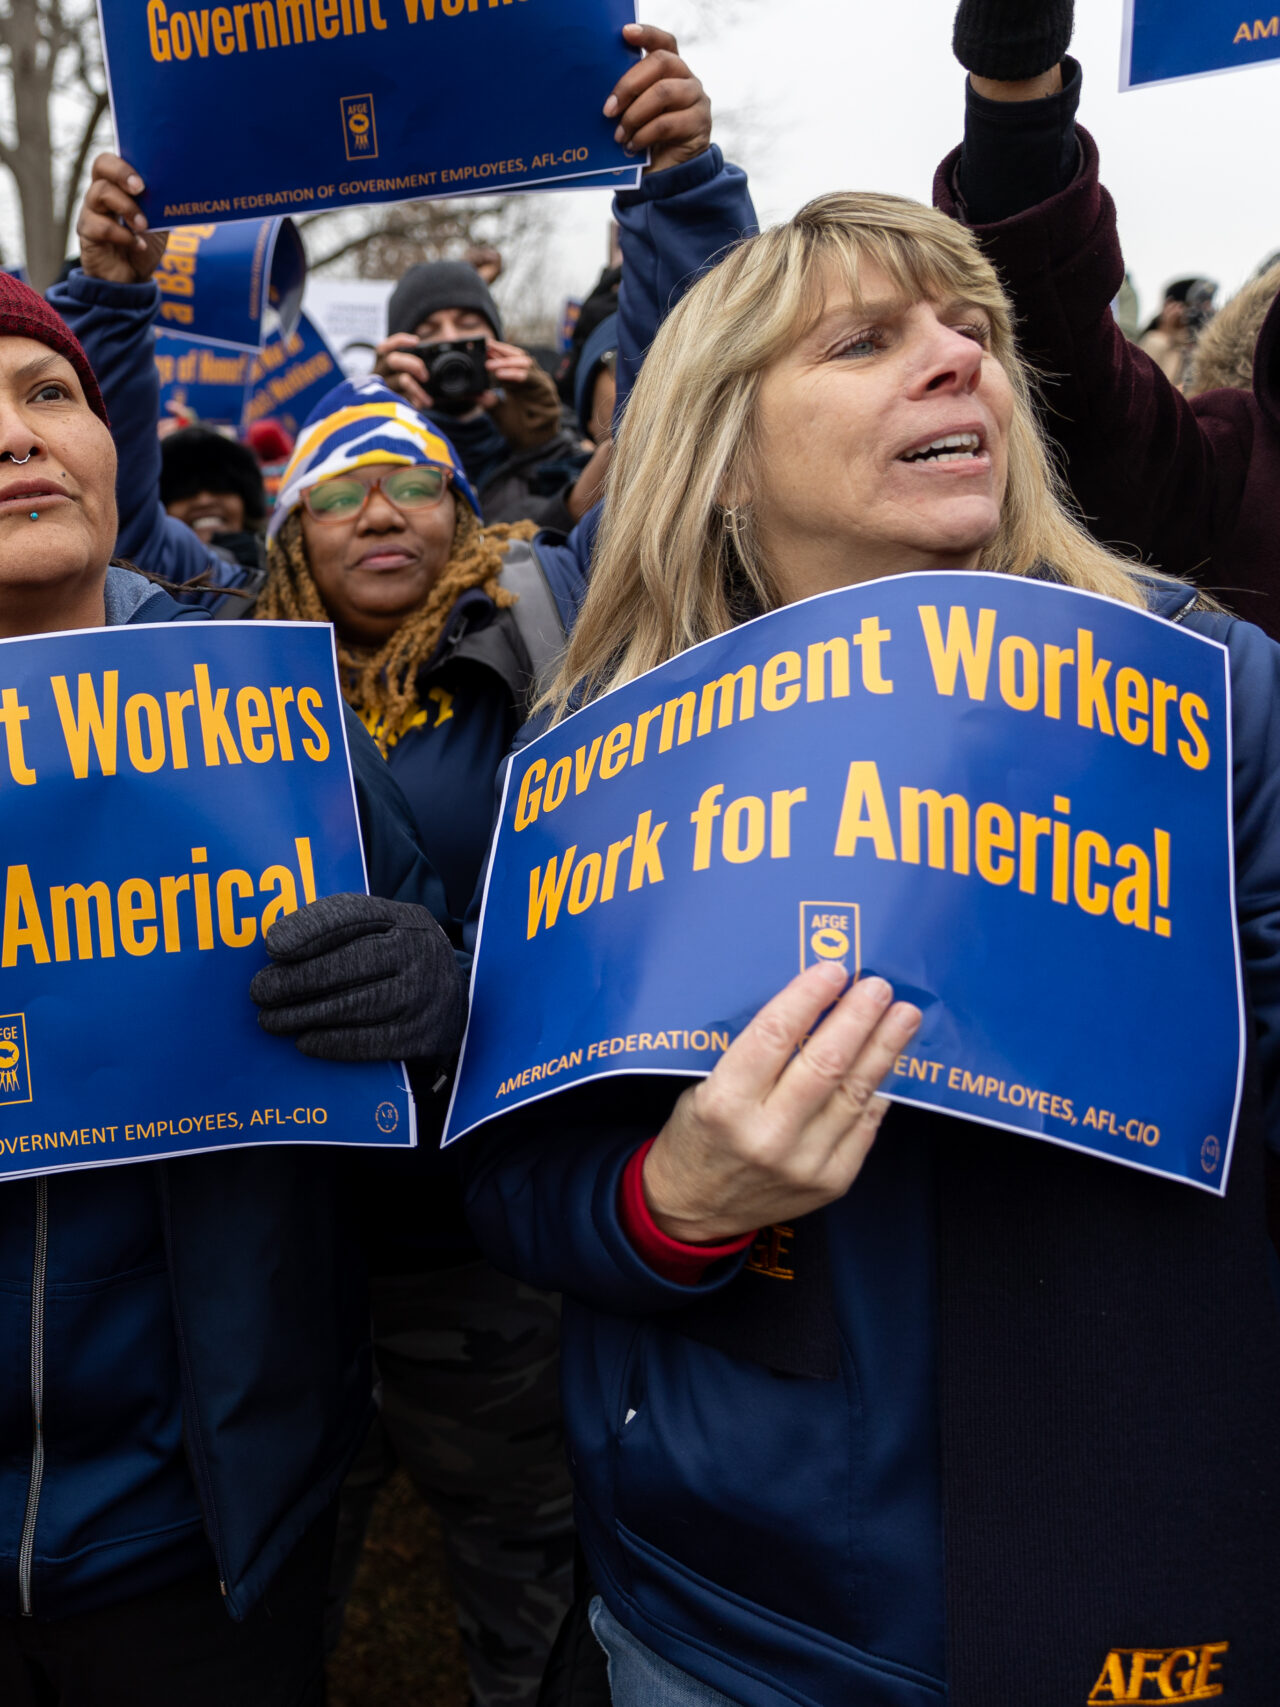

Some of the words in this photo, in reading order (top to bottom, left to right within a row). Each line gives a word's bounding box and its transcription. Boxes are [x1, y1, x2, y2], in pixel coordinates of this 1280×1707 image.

[147, 0, 387, 62] Government
[347, 104, 368, 117] AFGE
[163, 199, 230, 216] AMERICAN
[234, 188, 315, 210] FEDERATION
[317, 184, 335, 199] OF
[339, 173, 435, 196] GOVERNMENT
[441, 159, 528, 182] EMPLOYEES,
[532, 147, 589, 168] AFL-CIO
[50, 663, 330, 779] Workers
[514, 616, 894, 832] Government
[919, 605, 1210, 770] Workers
[527, 809, 668, 940] Work
[690, 783, 807, 871] for
[834, 761, 1171, 937] America!
[811, 915, 849, 931] AFGE
[497, 1048, 583, 1099] AMERICAN
[587, 1030, 729, 1060] FEDERATION
[124, 1112, 245, 1141] EMPLOYEES,
[250, 1106, 328, 1126] AFL-CIO
[948, 1068, 1079, 1125] EMPLOYEES,
[1083, 1106, 1160, 1147] AFL-CIO
[1087, 1641, 1229, 1706] AFGE
